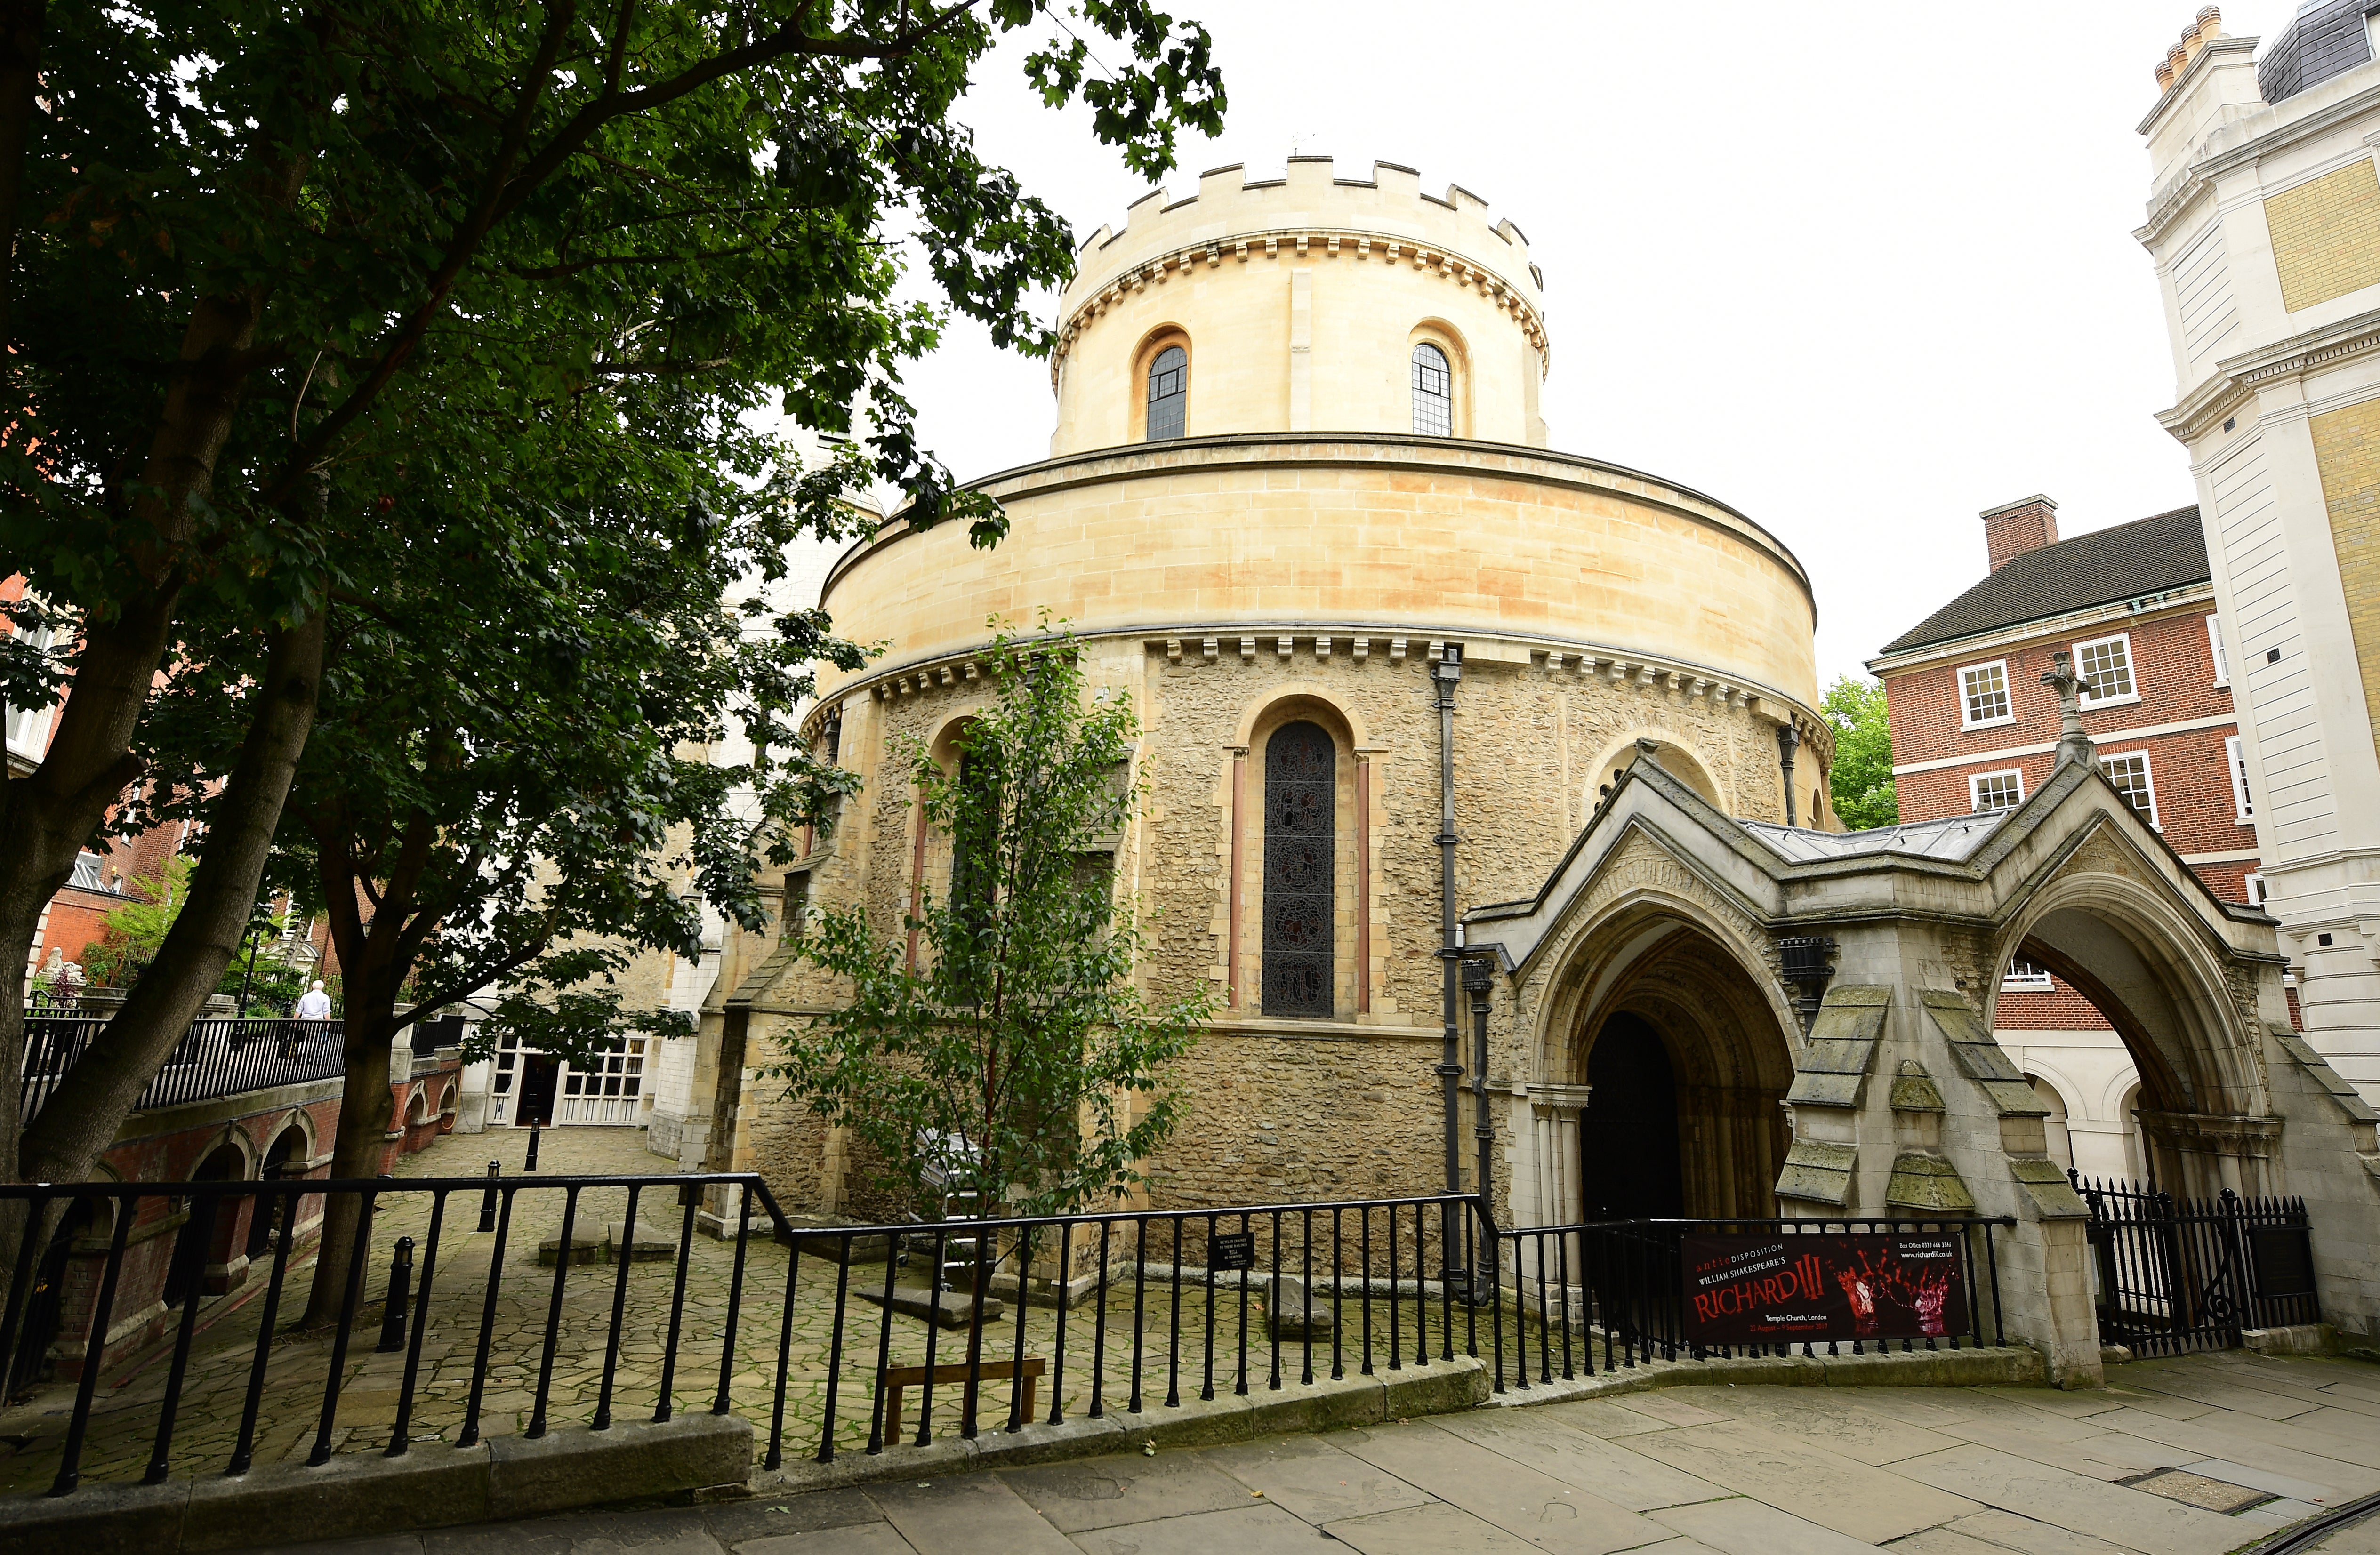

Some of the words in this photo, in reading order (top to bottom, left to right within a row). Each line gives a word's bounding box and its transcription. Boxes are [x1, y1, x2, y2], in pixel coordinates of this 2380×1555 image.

[1698, 1271, 1729, 1286] WILLIAM
[1730, 1256, 1786, 1278] SHAKESPEARE'S
[1693, 1271, 1798, 1323] RICHARD
[1794, 1254, 1825, 1300] III
[1765, 1315, 1785, 1323] Temple
[1786, 1323, 1814, 1332] September
